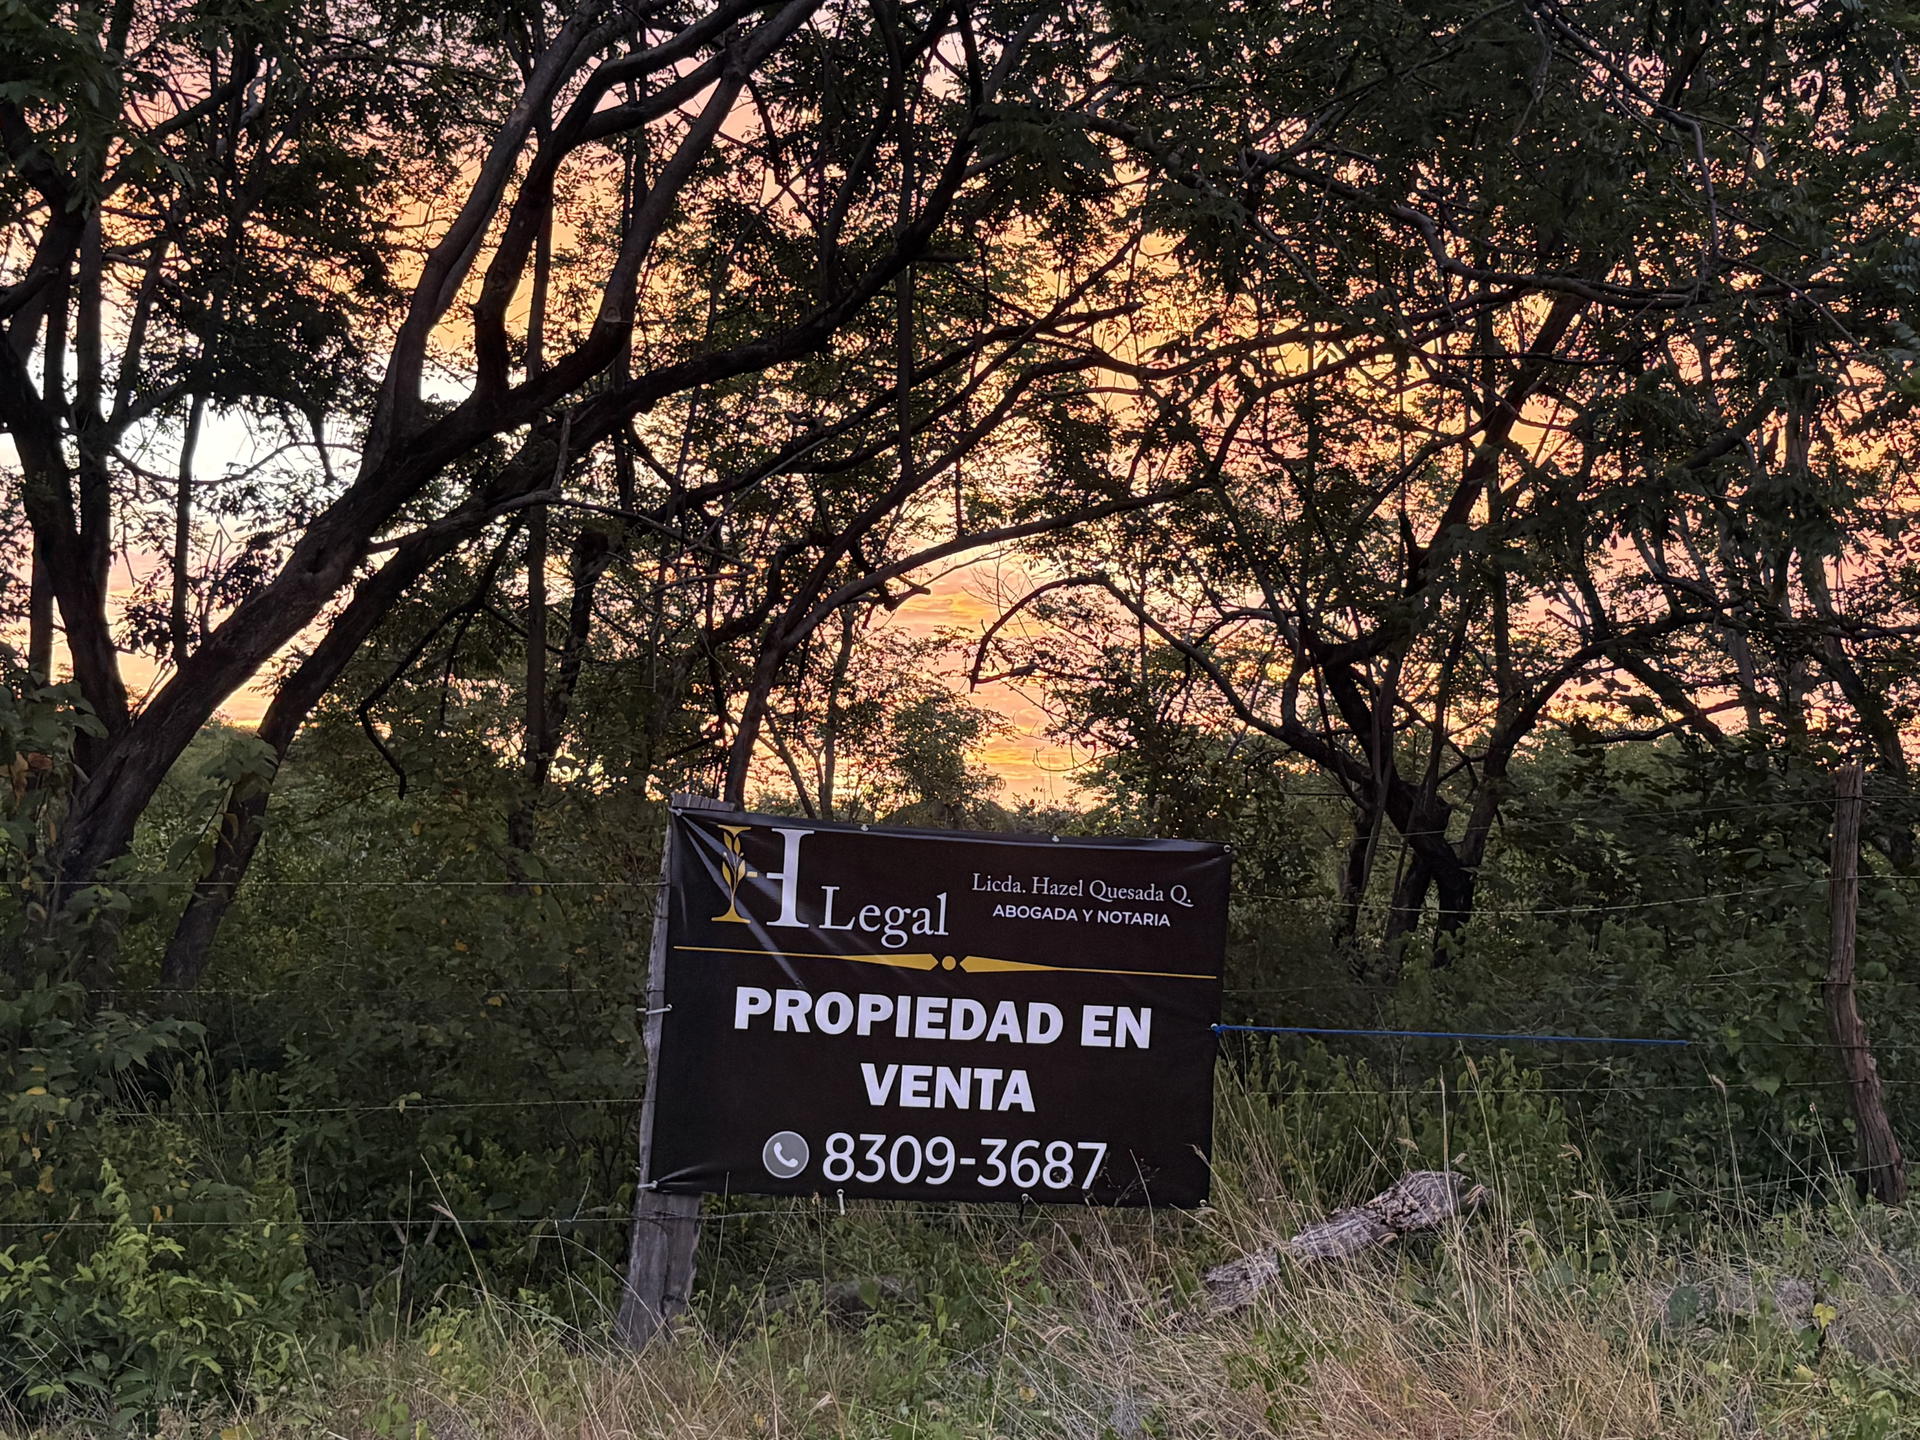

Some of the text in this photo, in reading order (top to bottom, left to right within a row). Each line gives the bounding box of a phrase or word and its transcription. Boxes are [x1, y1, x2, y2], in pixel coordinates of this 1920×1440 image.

[818, 885, 949, 948] Legal
[972, 873, 1194, 908] Licda. Hazel Quesada Q.
[992, 904, 1171, 927] ABOGADA Y NOTARIA
[734, 986, 1152, 1049] PROPIEDAD EN
[860, 1062, 1036, 1112] VENTA
[822, 1132, 1108, 1190] 8309-3687
